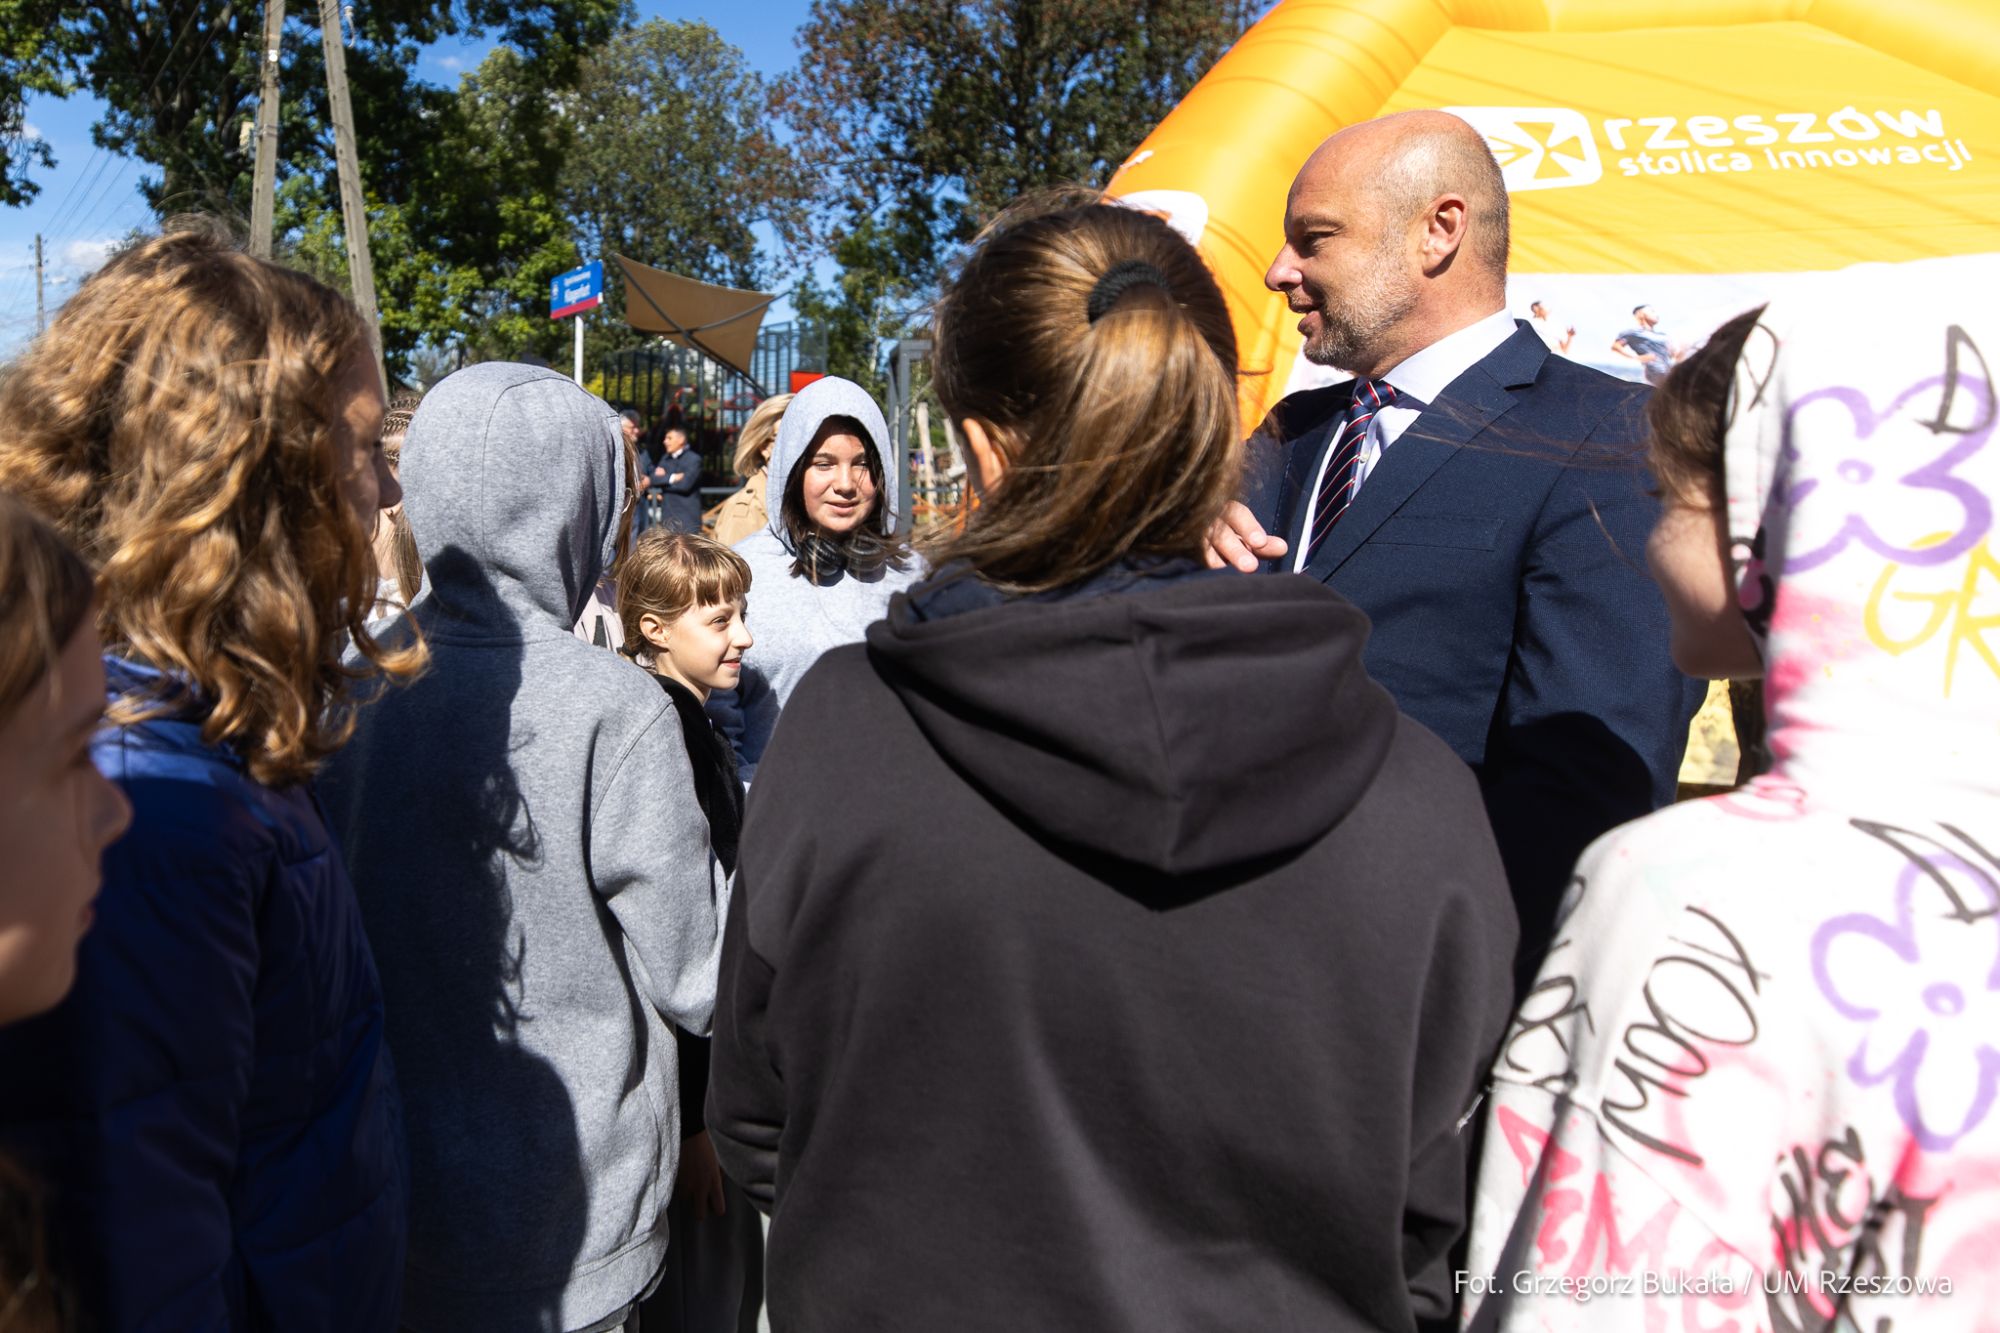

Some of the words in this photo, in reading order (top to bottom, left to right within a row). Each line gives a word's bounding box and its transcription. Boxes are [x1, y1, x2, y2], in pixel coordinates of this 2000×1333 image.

[1605, 106, 1944, 147] rzeszów
[1621, 149, 1750, 176] stolica
[1767, 140, 1972, 170] innowacji
